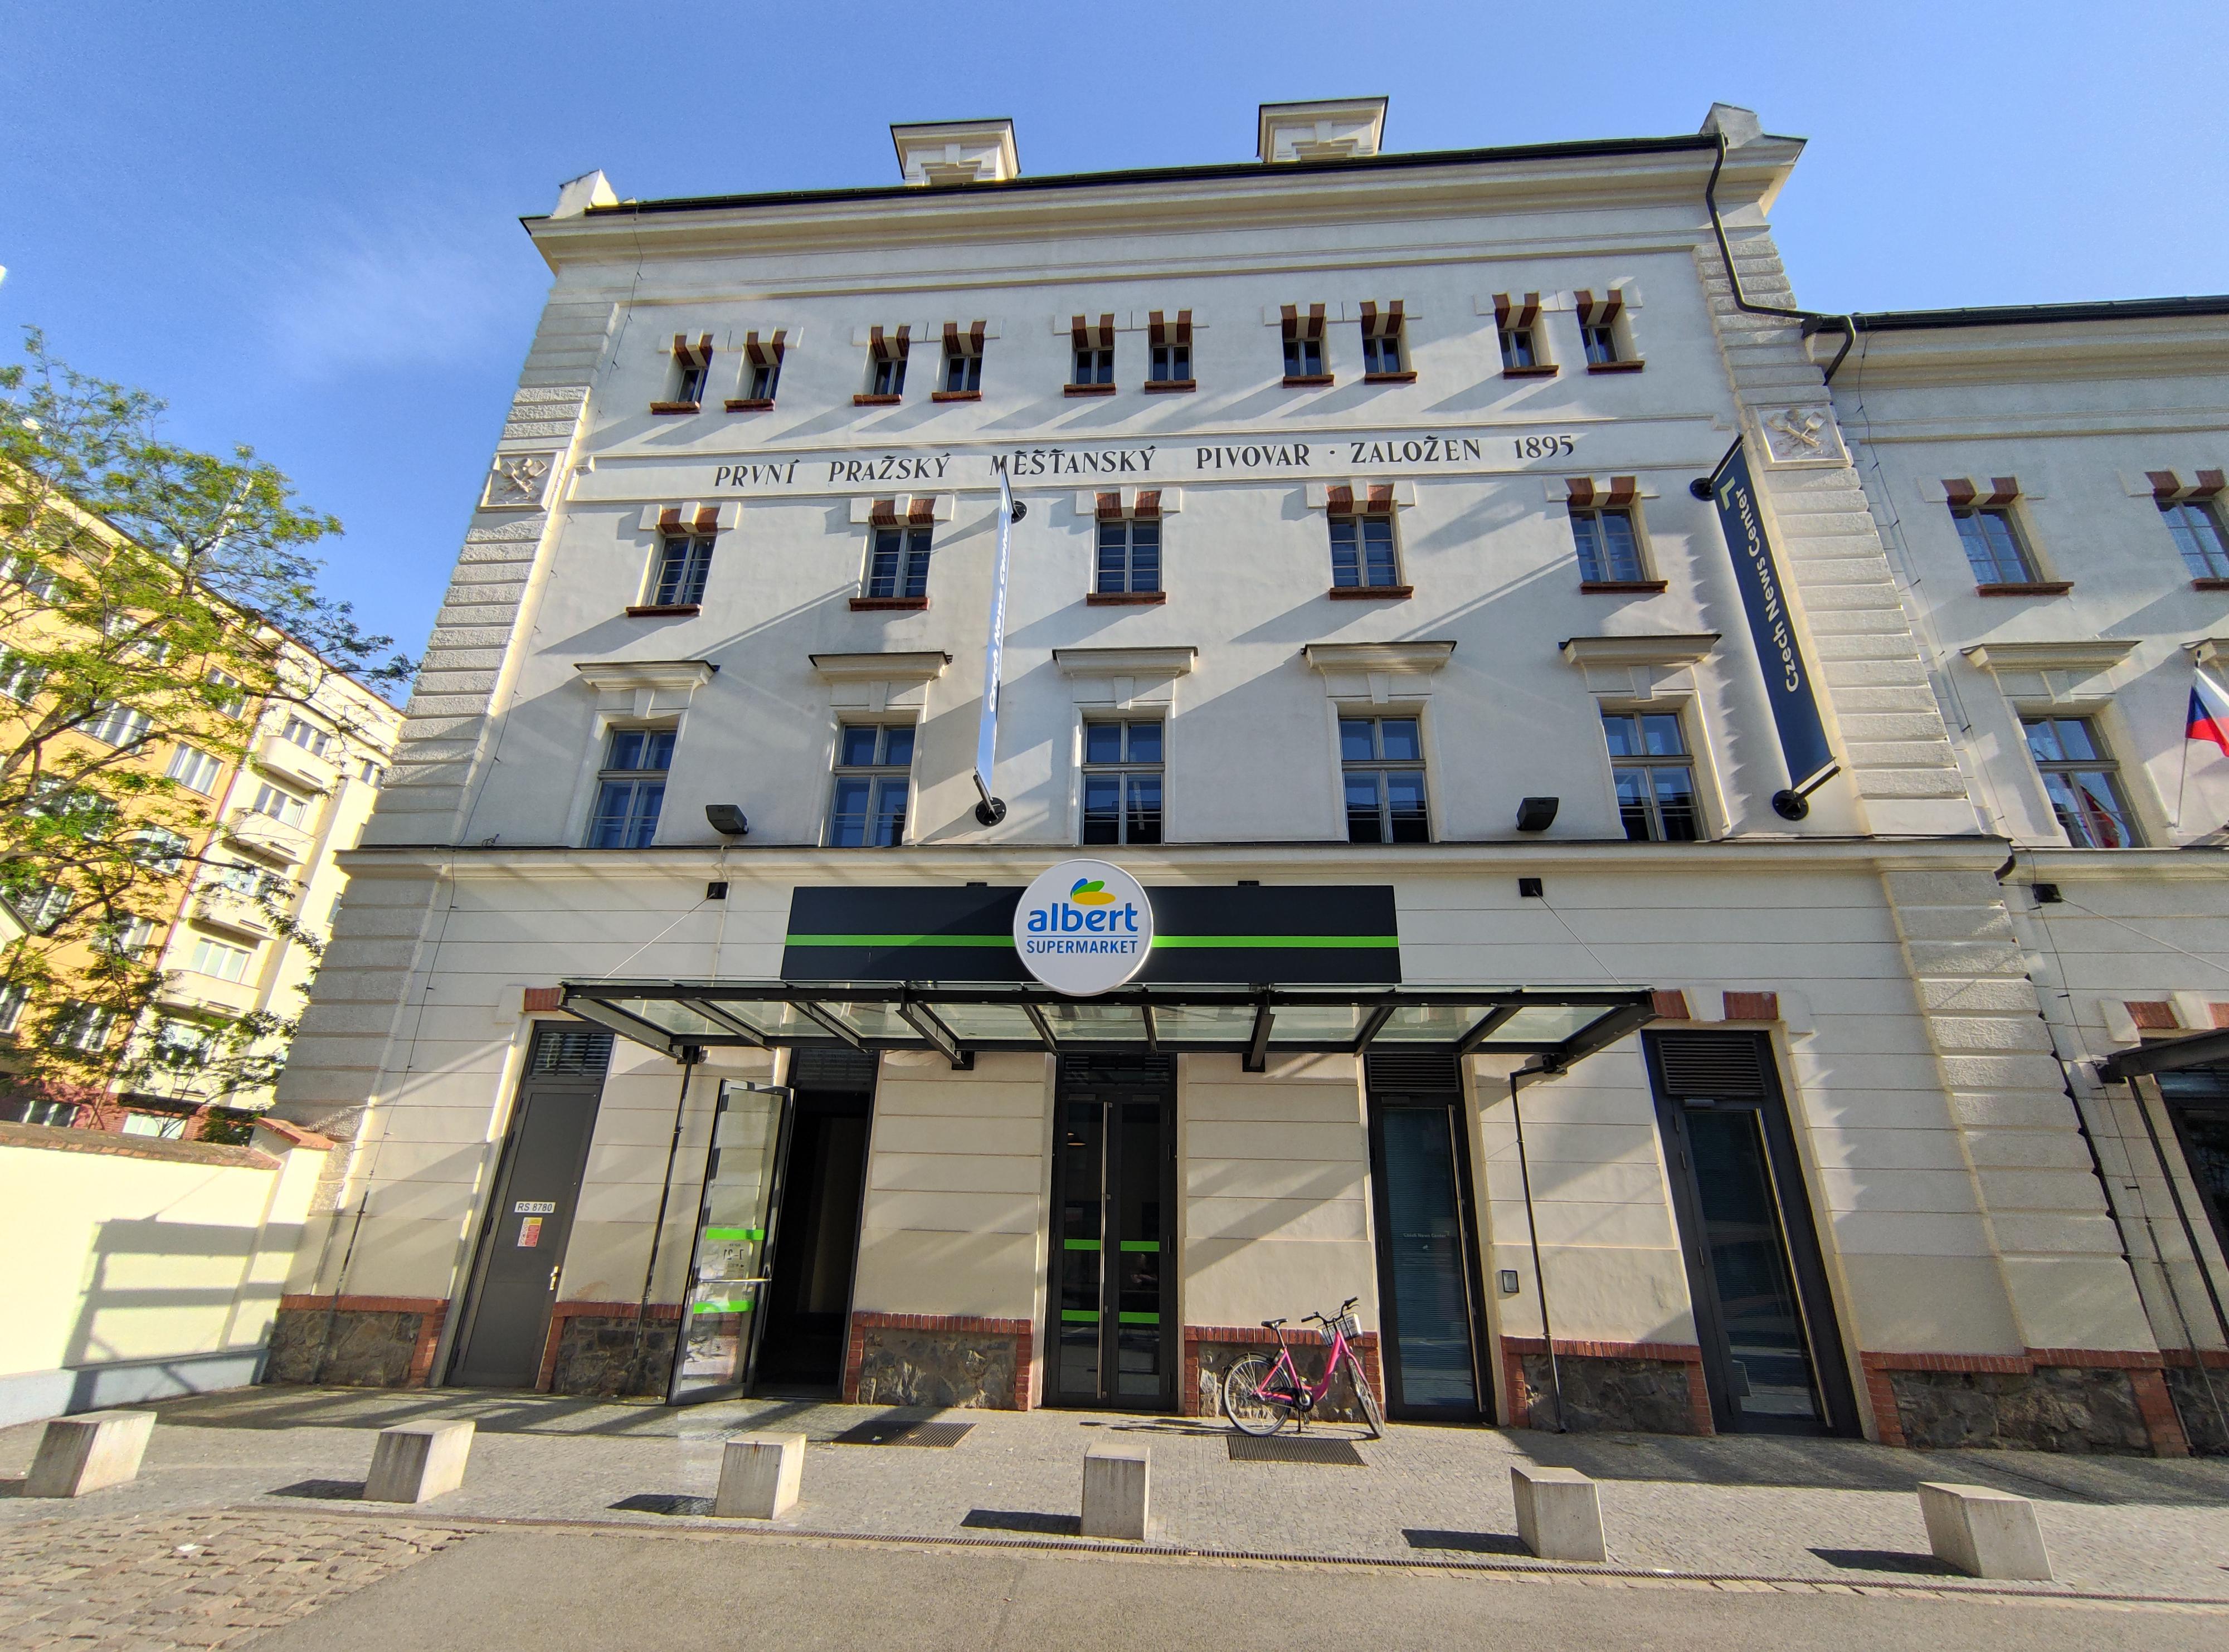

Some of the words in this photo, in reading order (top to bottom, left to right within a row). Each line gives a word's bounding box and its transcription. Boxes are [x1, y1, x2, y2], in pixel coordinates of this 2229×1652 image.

[714, 459, 801, 487] PRVNÍ
[828, 452, 951, 483] PRAŽSKÝ
[990, 445, 1157, 475] MĚŠŤANSKÝ
[1196, 444, 1310, 469] PIVOVAR
[1351, 436, 1481, 464] ZALOŽEN
[1514, 435, 1574, 459] 1895
[1735, 486, 1760, 557] Center
[1757, 557, 1780, 623] News
[1773, 620, 1799, 692] Czech
[1027, 902, 1138, 932] albert
[1026, 940, 1138, 954] SUPERMARKET
[517, 1203, 530, 1211] RS
[532, 1203, 552, 1212] 8780
